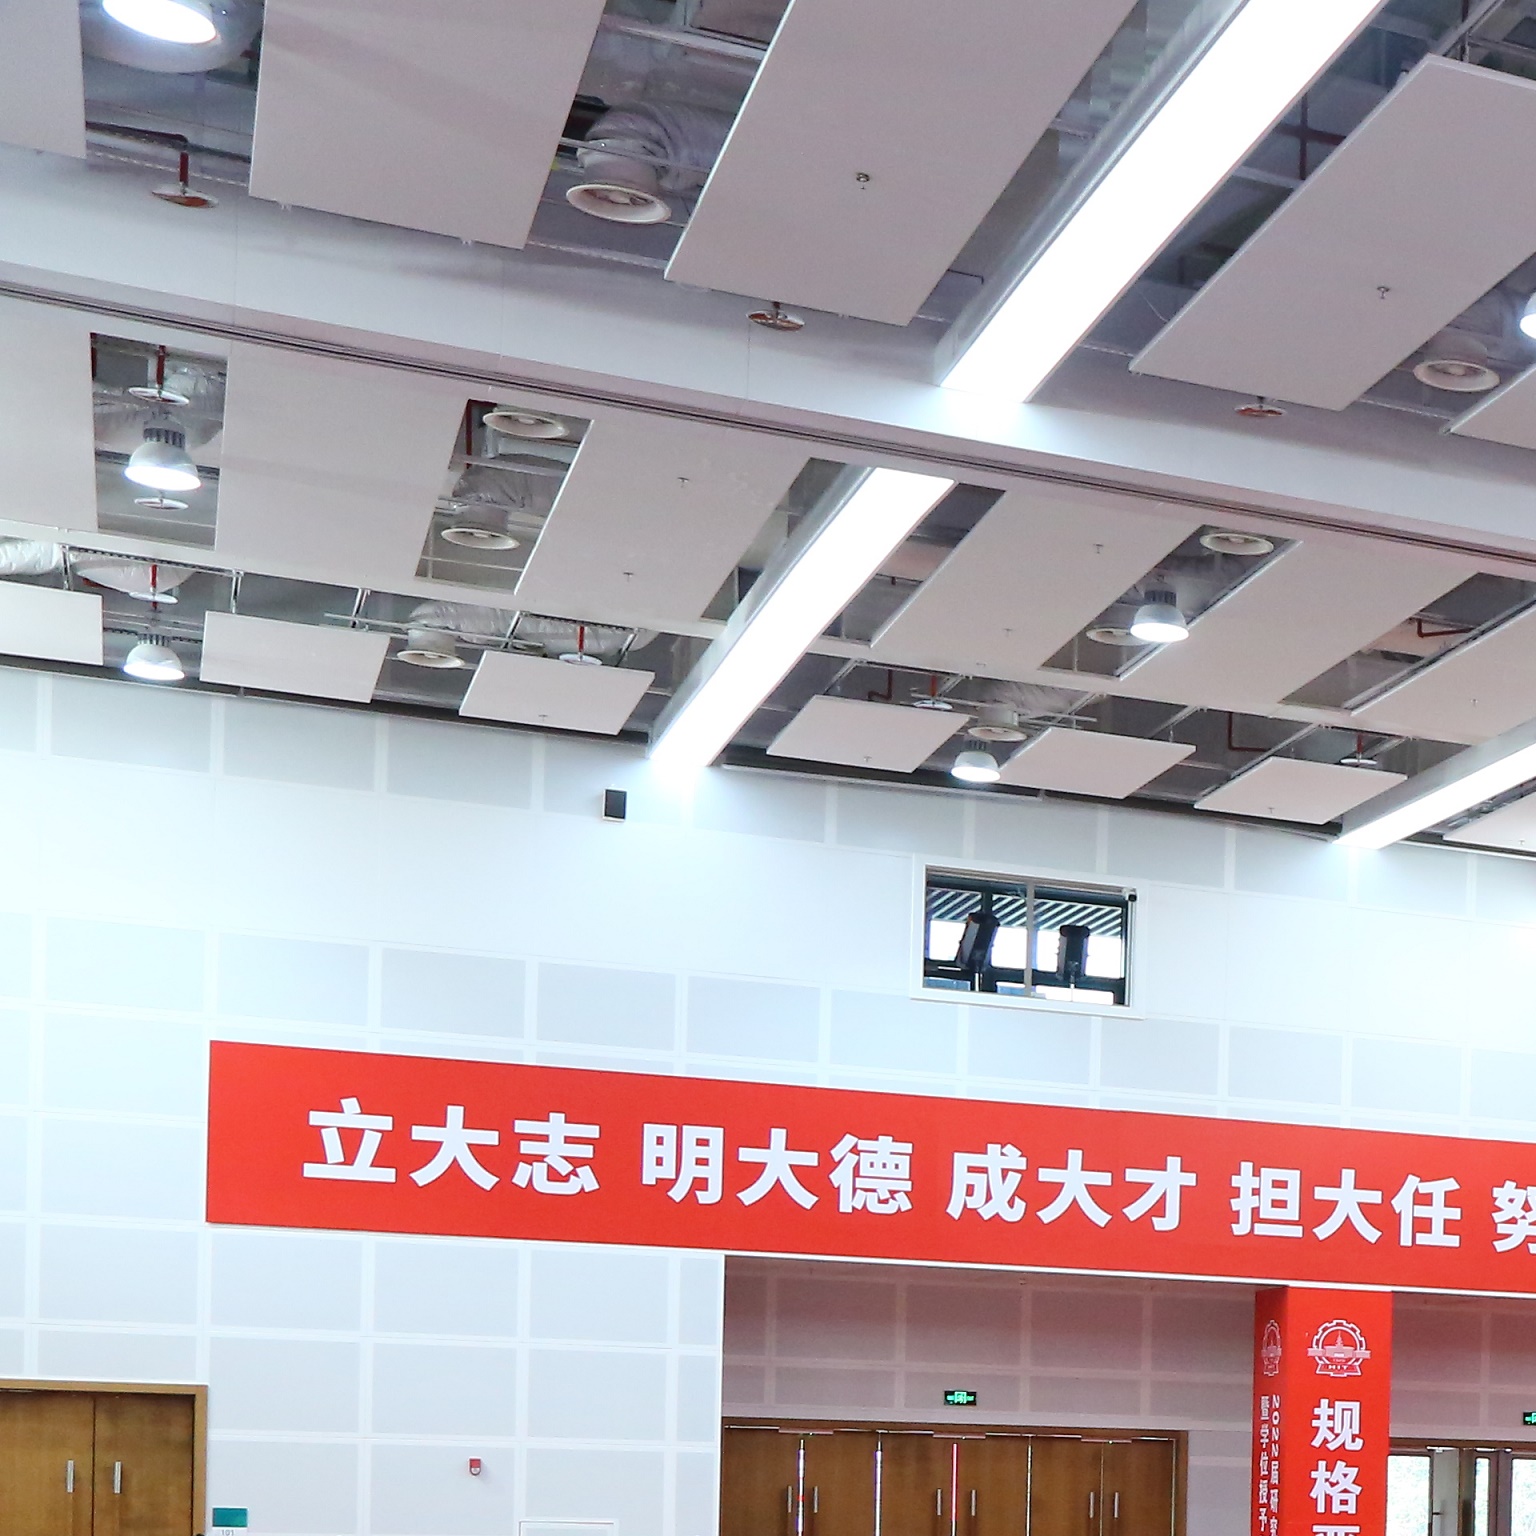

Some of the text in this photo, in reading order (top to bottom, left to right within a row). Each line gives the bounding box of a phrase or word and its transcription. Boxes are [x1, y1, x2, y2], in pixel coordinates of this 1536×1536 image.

[302, 1096, 600, 1196] 立大志
[641, 1122, 914, 1216] 明大德
[944, 1142, 1197, 1233] 成大才
[1230, 1160, 1462, 1248] 担大任
